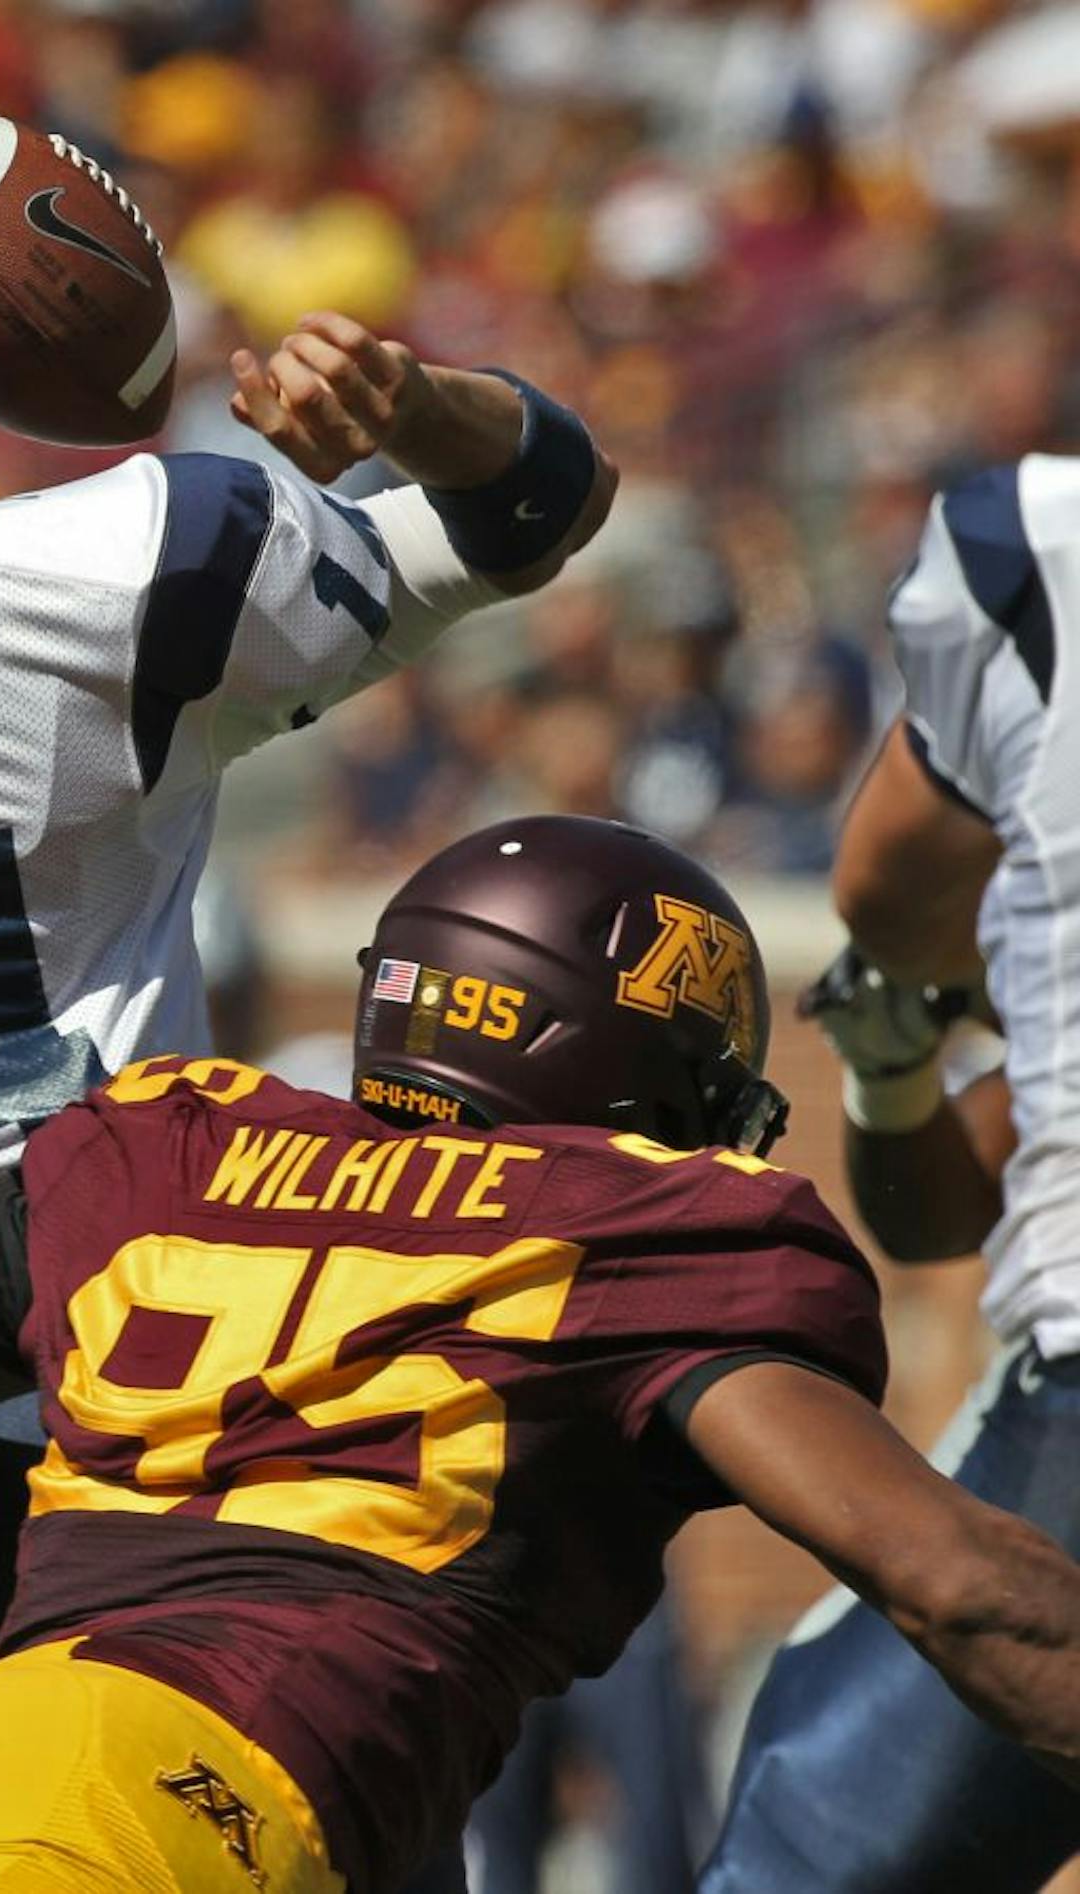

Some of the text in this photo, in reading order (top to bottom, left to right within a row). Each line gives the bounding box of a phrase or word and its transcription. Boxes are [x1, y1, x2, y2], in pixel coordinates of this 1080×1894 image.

[444, 975, 526, 1041] 95
[361, 1078, 461, 1122] SKI-U-MAH
[203, 1125, 542, 1220] WILHITE
[26, 1233, 587, 1575] 95
